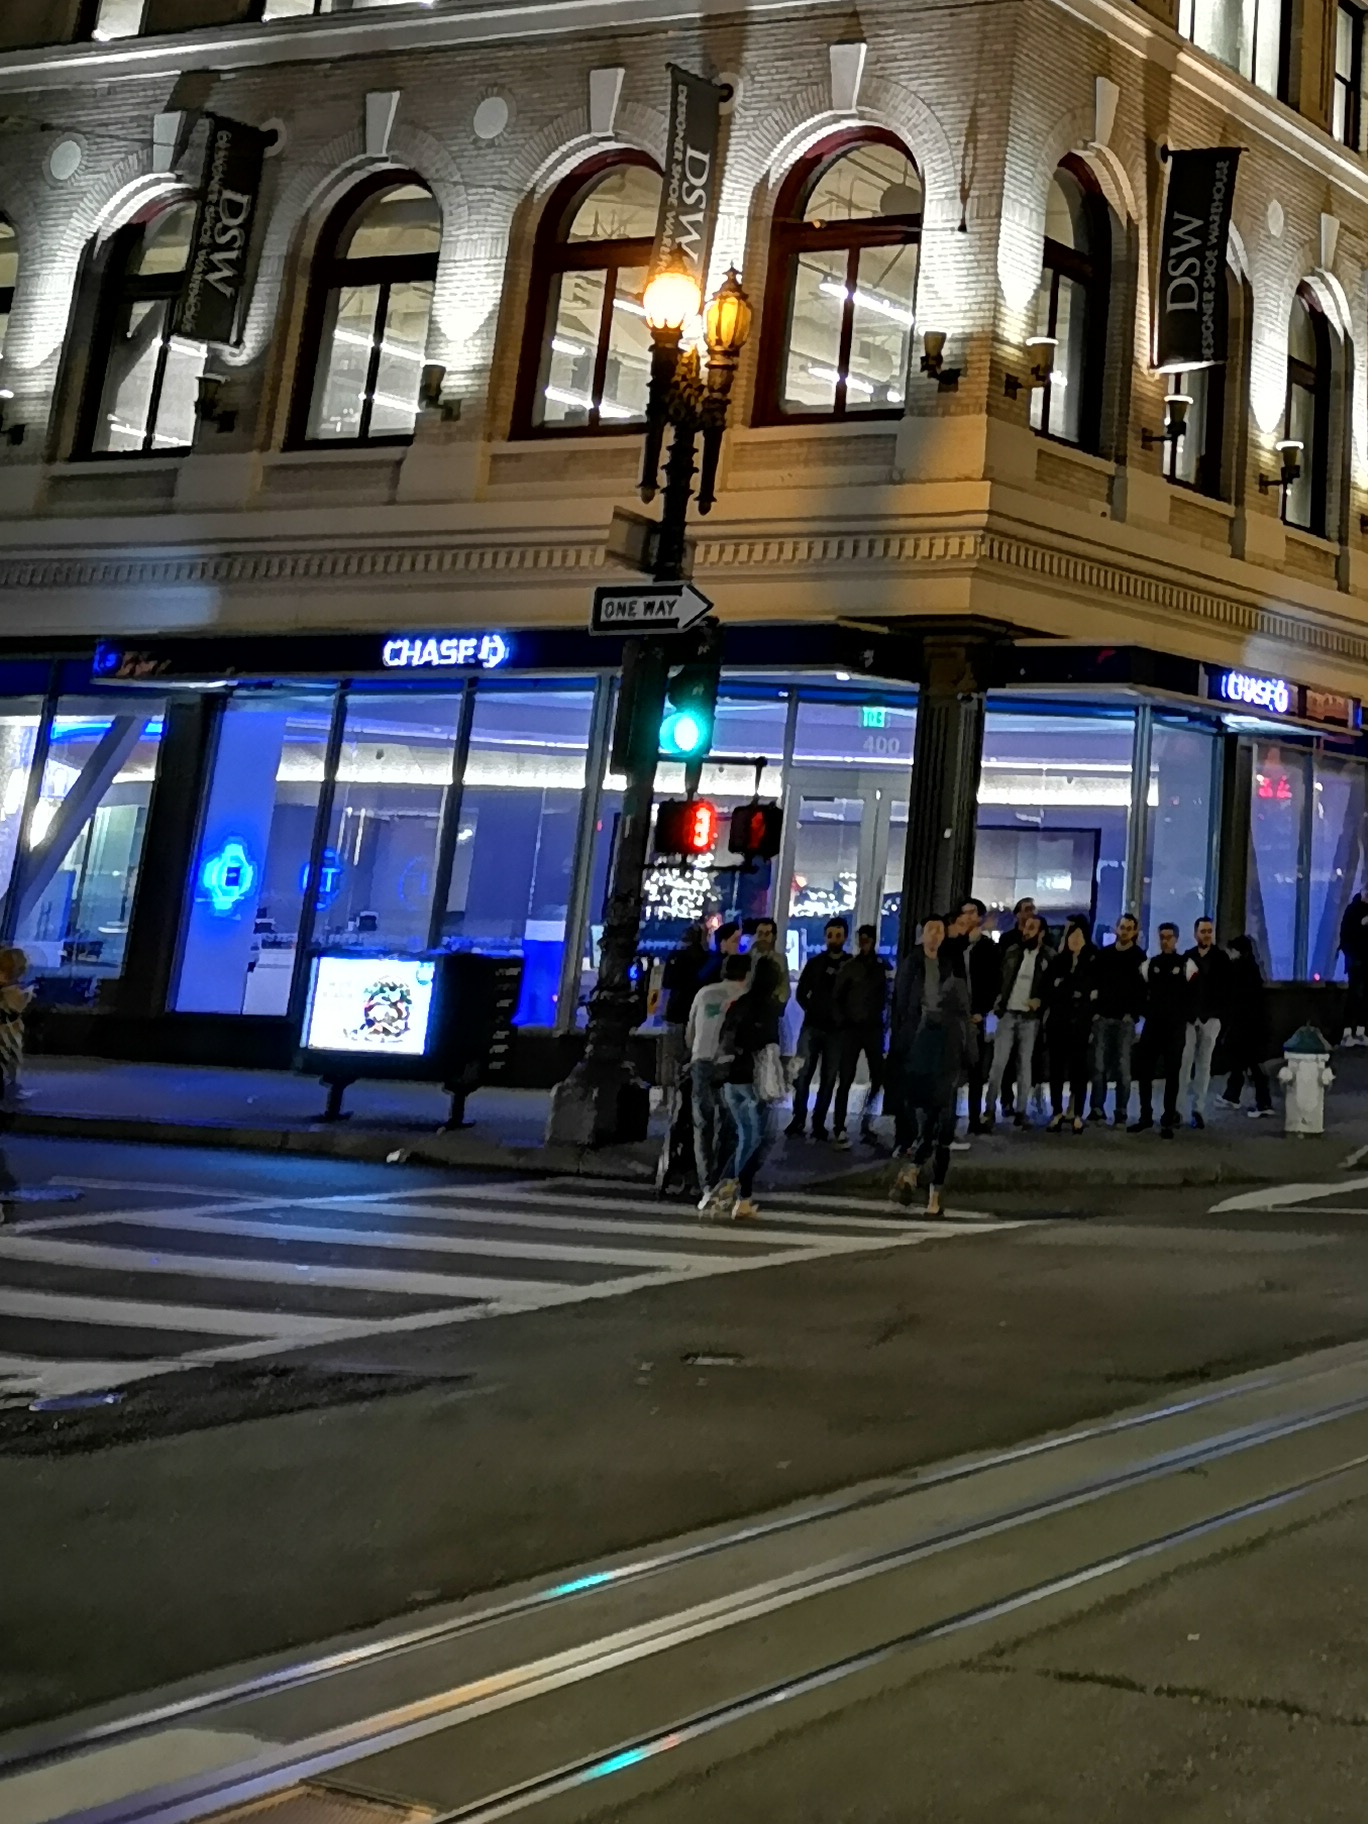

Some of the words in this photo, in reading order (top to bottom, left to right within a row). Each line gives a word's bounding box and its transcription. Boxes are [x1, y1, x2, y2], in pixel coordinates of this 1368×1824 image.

[667, 162, 682, 206] SHOE
[675, 144, 710, 264] DSW
[1207, 160, 1230, 246] WAREHOUSE
[204, 188, 250, 299] DSW
[1166, 211, 1204, 313] DSW
[1203, 249, 1218, 288] SHOE
[1201, 291, 1215, 360] DESIGNER
[605, 601, 637, 618] ONE
[643, 599, 677, 617] WAY
[383, 638, 478, 666] CHASE
[863, 735, 900, 754] 400
